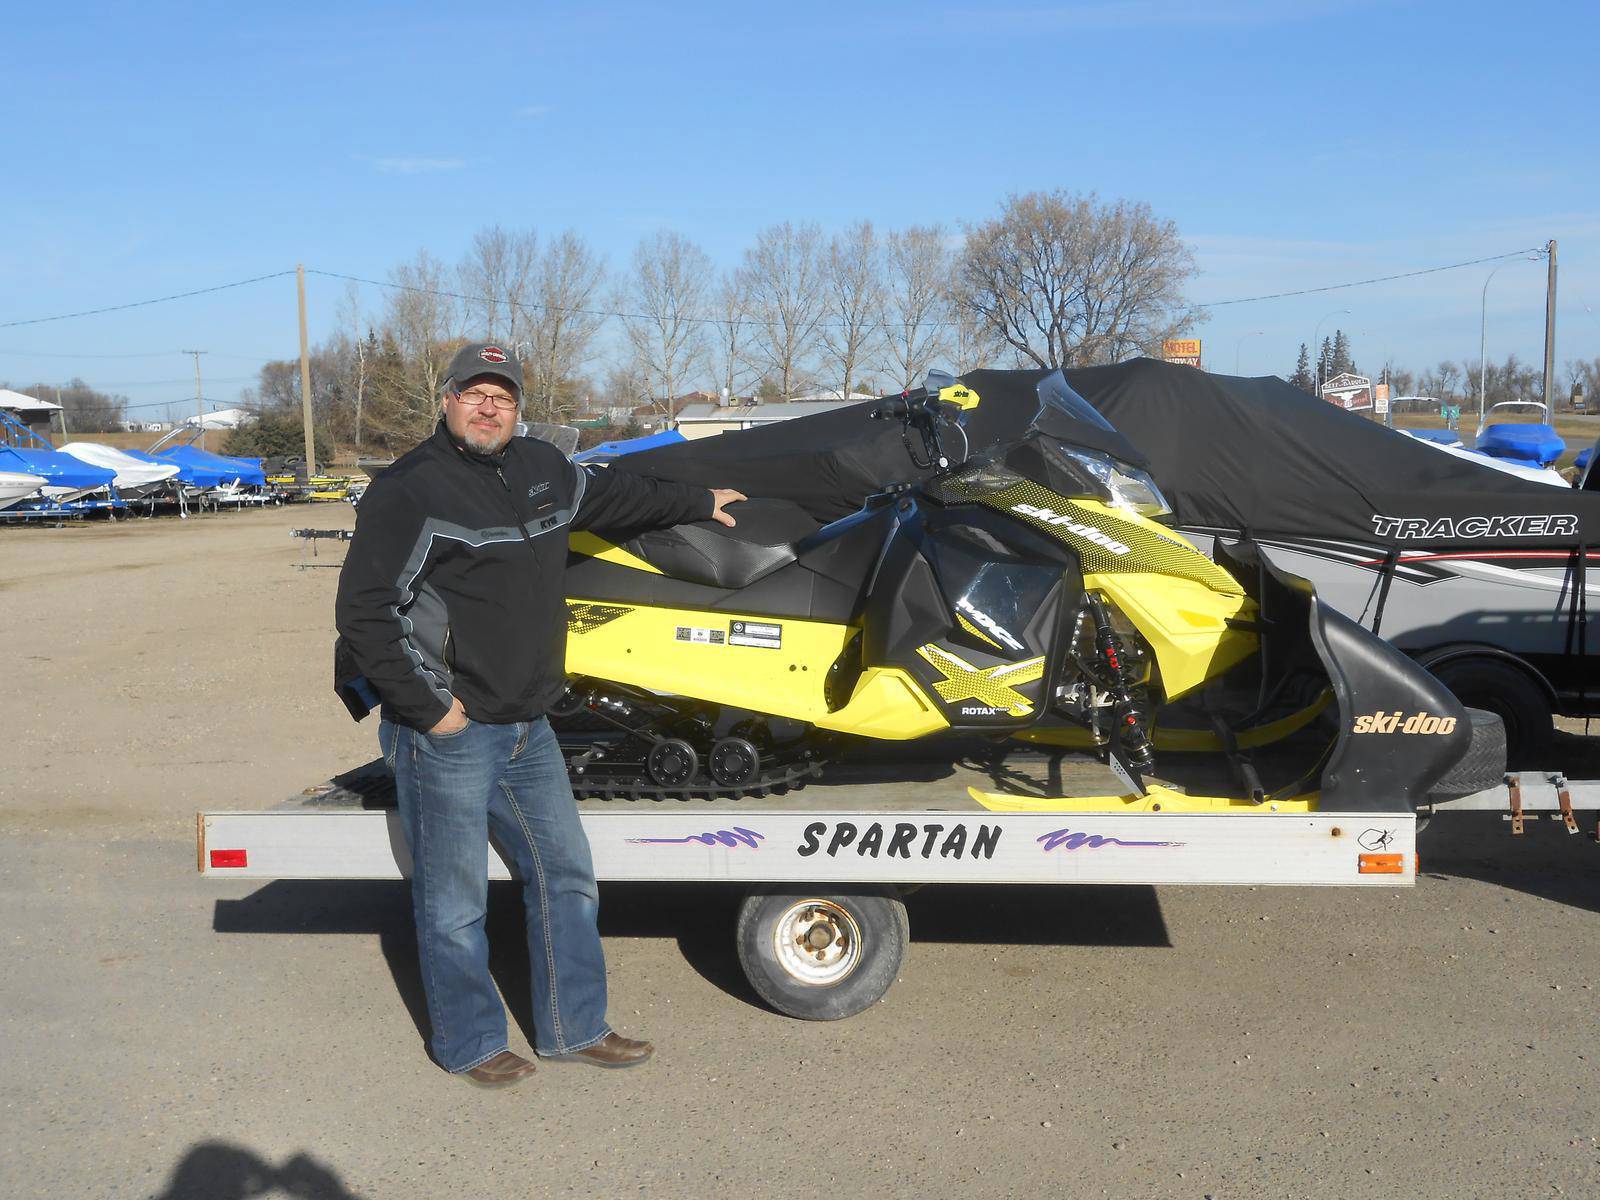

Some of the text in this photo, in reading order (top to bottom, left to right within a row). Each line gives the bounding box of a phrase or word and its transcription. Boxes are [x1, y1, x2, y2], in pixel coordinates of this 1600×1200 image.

[1165, 341, 1198, 354] MOTEL
[1010, 503, 1132, 556] ski-doo
[1371, 514, 1578, 539] TRACKER
[961, 707, 996, 715] ROTAX
[1353, 711, 1457, 735] ski-doo
[797, 821, 1003, 860] SPARTAN
